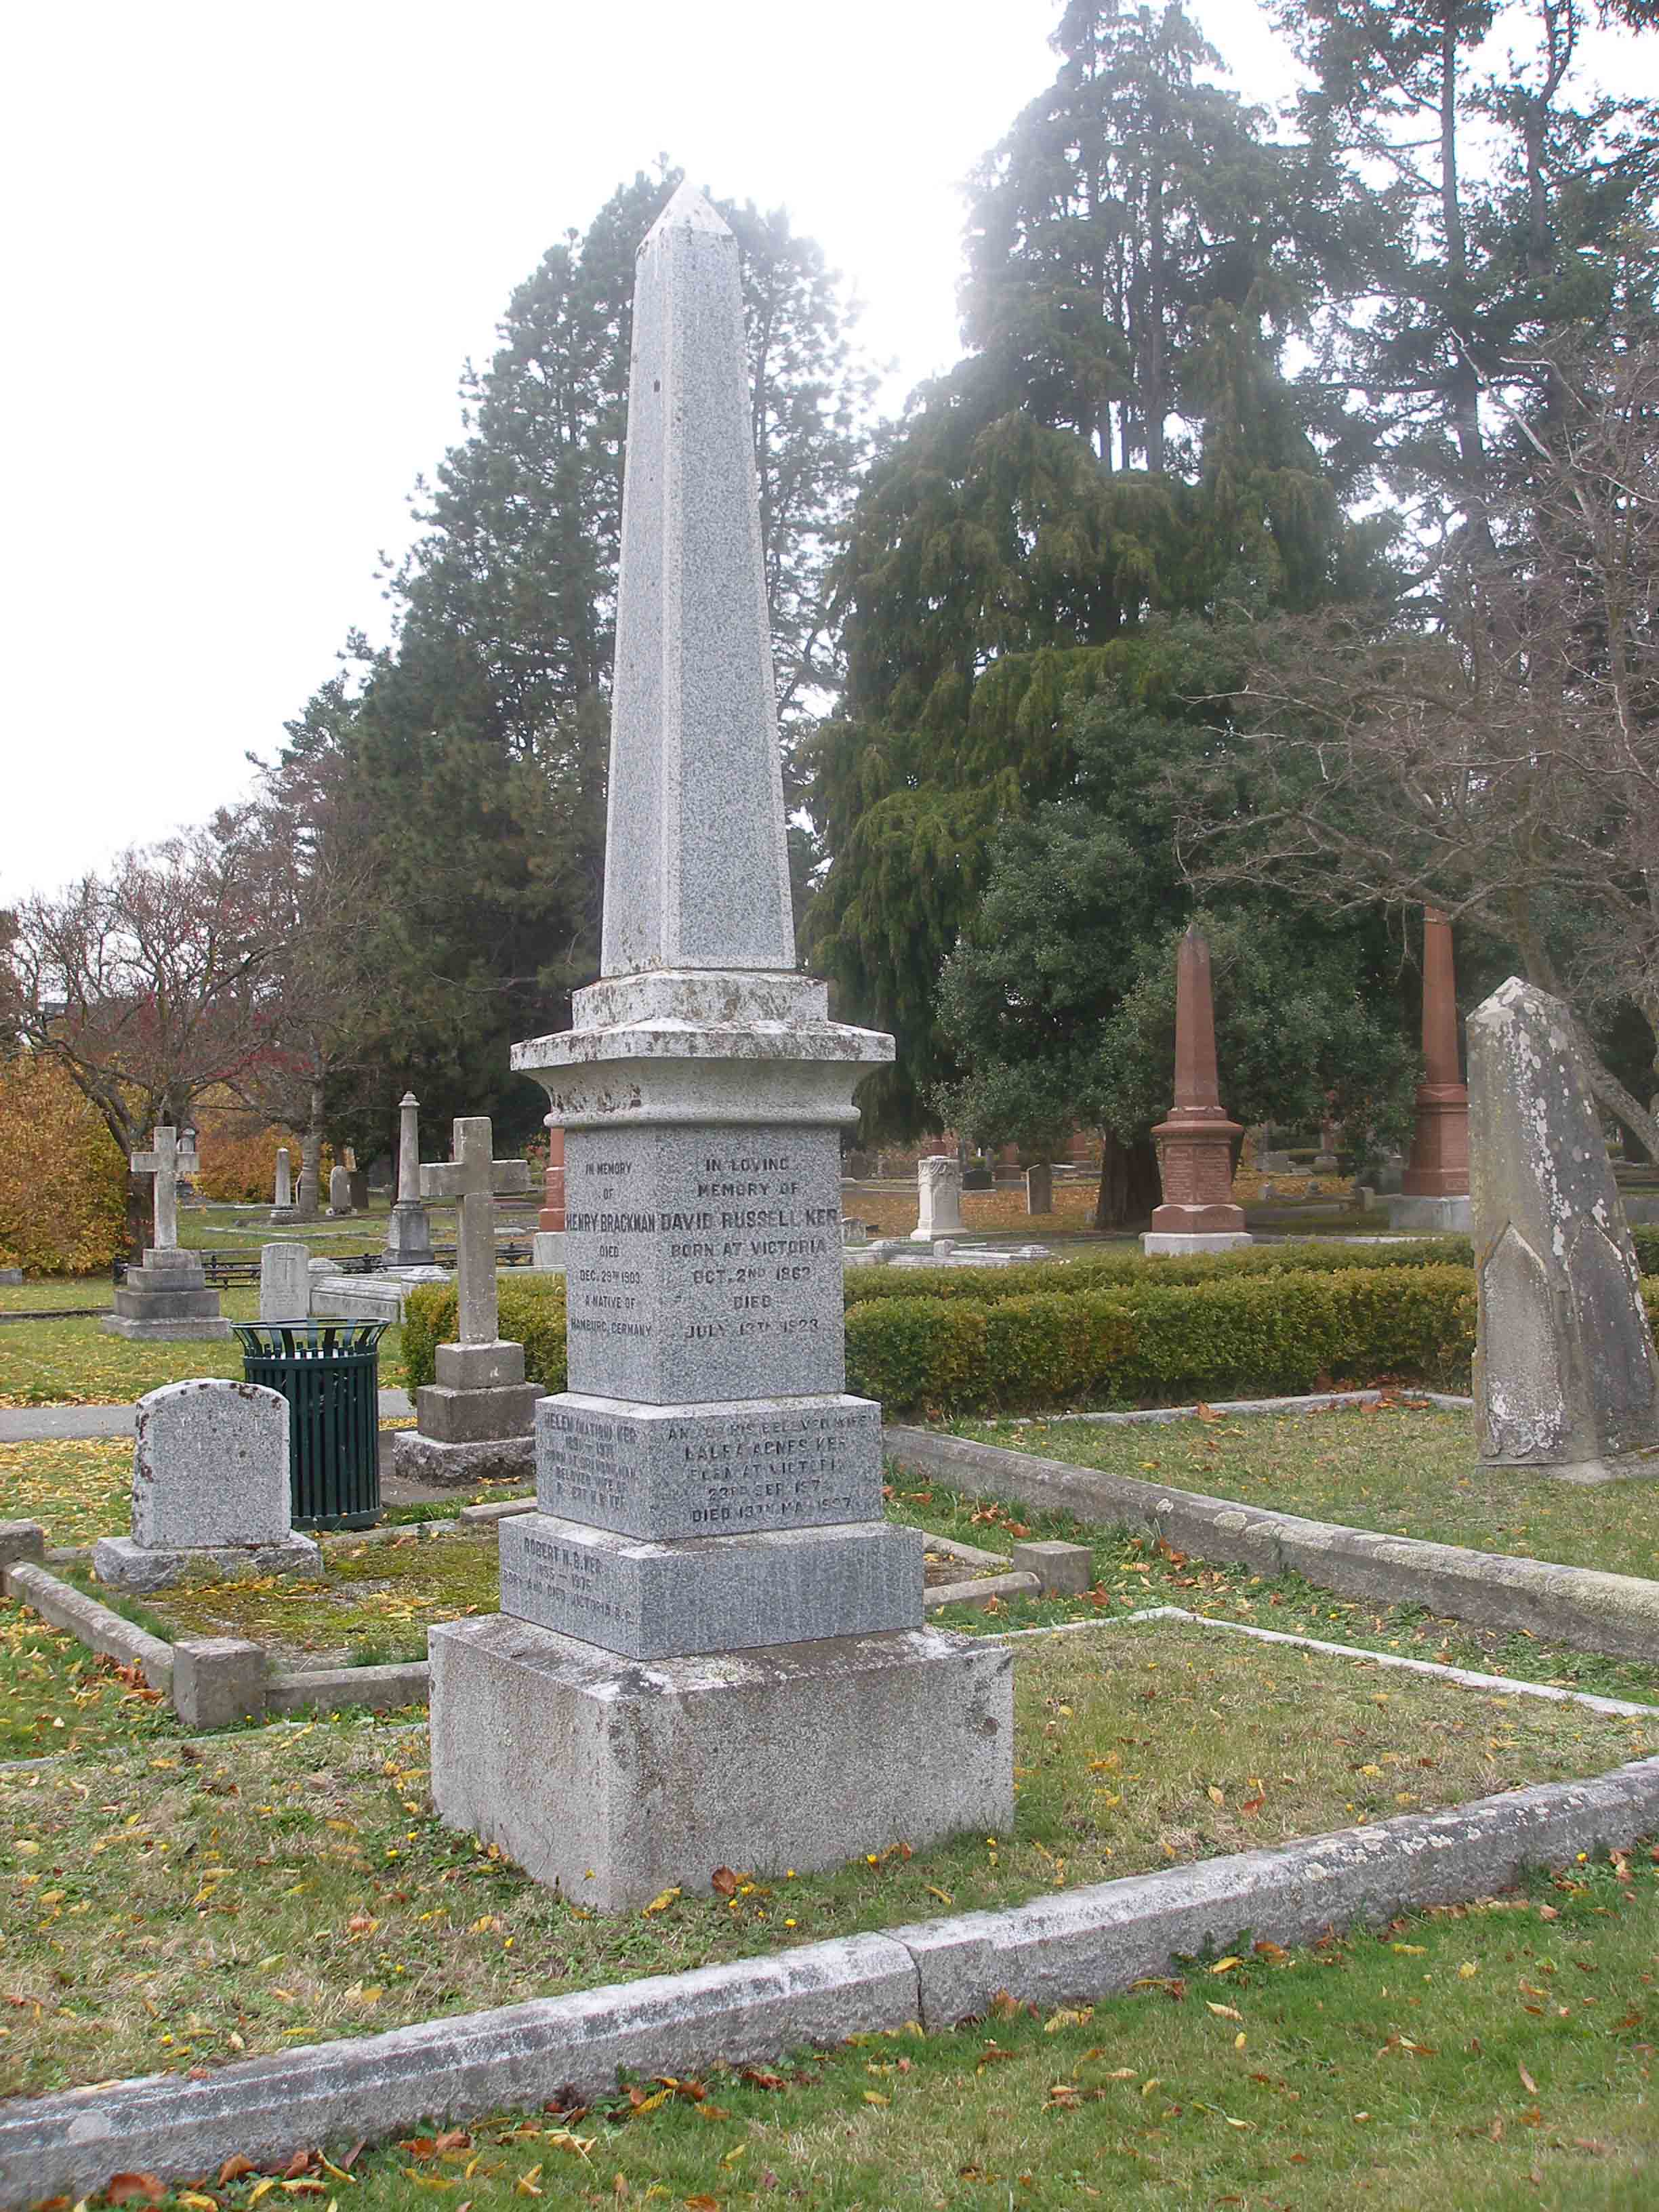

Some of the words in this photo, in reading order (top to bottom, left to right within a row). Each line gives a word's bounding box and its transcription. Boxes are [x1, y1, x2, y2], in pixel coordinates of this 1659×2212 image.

[586, 1163, 595, 1175] IN
[596, 1162, 632, 1175] MEMORY
[706, 1160, 720, 1172] IN
[731, 1158, 789, 1172] LOVING
[603, 1189, 613, 1200] OF
[697, 1183, 769, 1197] MEMORY
[781, 1183, 799, 1195] OF
[566, 1214, 598, 1232] HENRY
[600, 1214, 655, 1232] BRACKMAN
[661, 1212, 712, 1231] DAVID
[722, 1210, 801, 1229] RUSSELL
[805, 1208, 838, 1227] KER
[600, 1246, 619, 1258] DIED
[671, 1243, 714, 1258] BORN
[722, 1242, 743, 1256] AT
[752, 1240, 826, 1255] VICTORIA
[586, 1296, 590, 1307] A
[592, 1296, 622, 1309] NATIVE
[625, 1297, 636, 1309] OF
[734, 1295, 771, 1310] DIED
[687, 1324, 724, 1339] JULY
[693, 1507, 730, 1523] DIED
[525, 1537, 558, 1561] ROBERT
